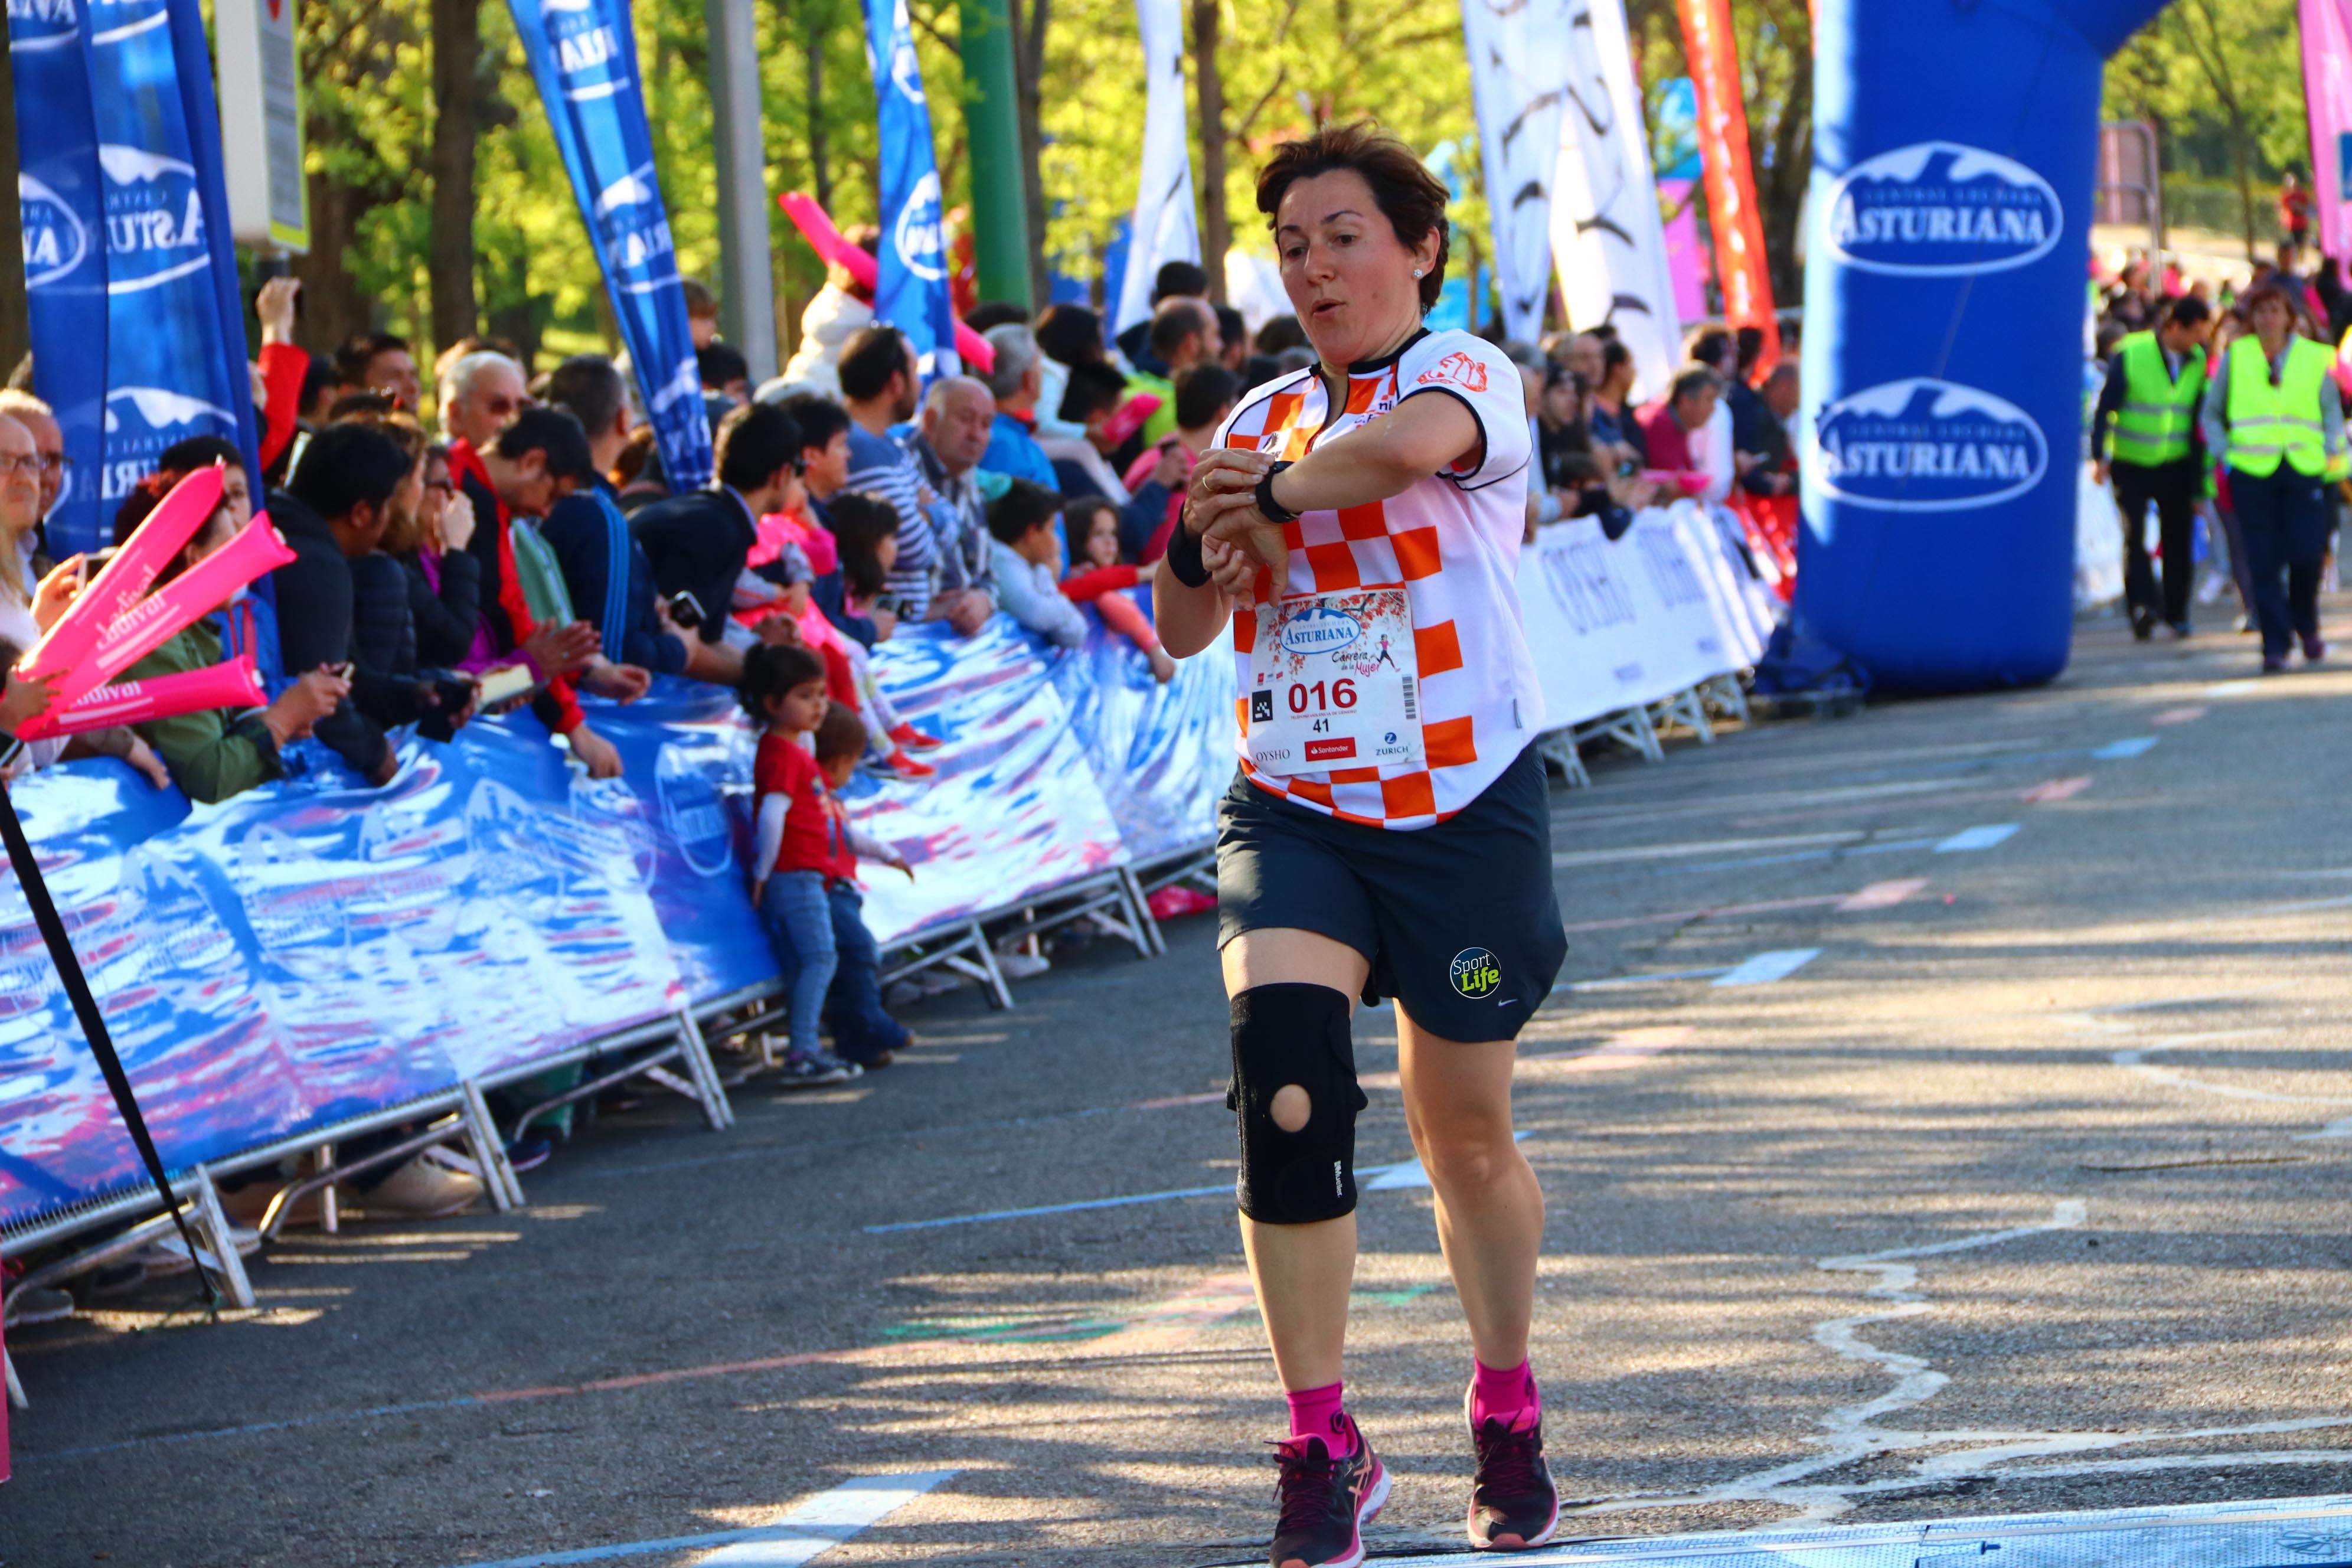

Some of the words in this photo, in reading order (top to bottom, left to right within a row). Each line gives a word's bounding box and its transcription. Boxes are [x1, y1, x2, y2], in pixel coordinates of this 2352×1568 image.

[1832, 190, 2047, 245] ASTURIANA
[1821, 425, 2031, 479] ASTURIANA
[1285, 627, 1354, 645] ASTURIANA
[1332, 651, 1368, 662] Carrera
[1354, 659, 1379, 677] Mujer
[1288, 678, 1357, 714] 016
[1313, 718, 1329, 733] 41
[1256, 749, 1291, 762] OYSHO
[1318, 745, 1348, 753] Santander
[1376, 746, 1409, 756] ZURICH
[1334, 1165, 1342, 1196] Mueller
